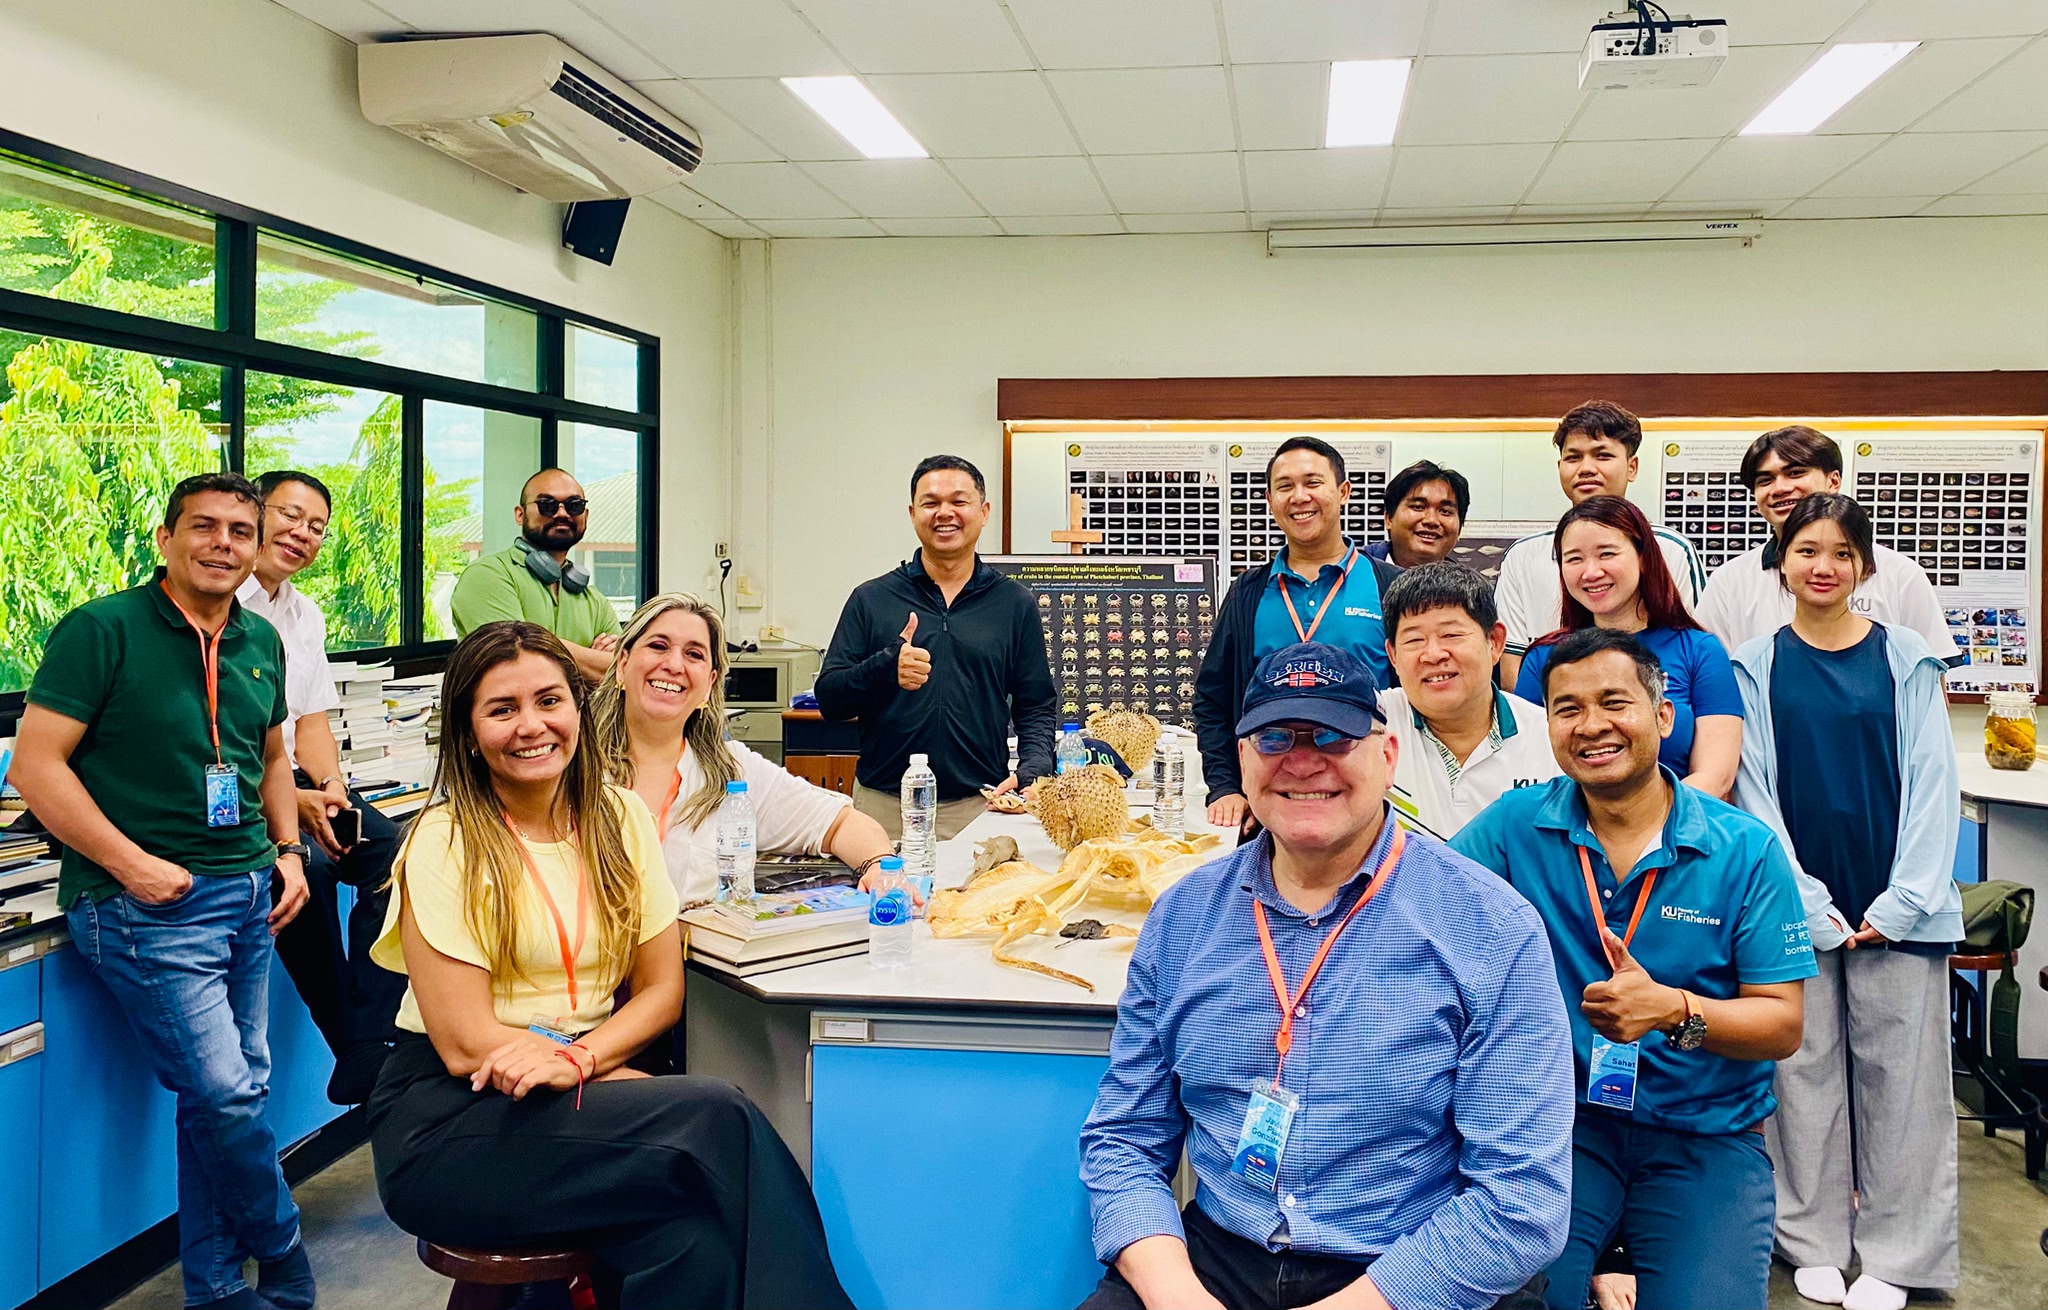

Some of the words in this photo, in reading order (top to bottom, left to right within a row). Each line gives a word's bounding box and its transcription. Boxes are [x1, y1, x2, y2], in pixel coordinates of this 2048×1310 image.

[1850, 597, 1872, 612] KU
[1265, 661, 1345, 683] BERGEN
[1661, 905, 1677, 917] KU
[1677, 912, 1721, 926] Fisheries
[1784, 933, 1796, 943] 12
[1612, 1057, 1636, 1068] Sahat
